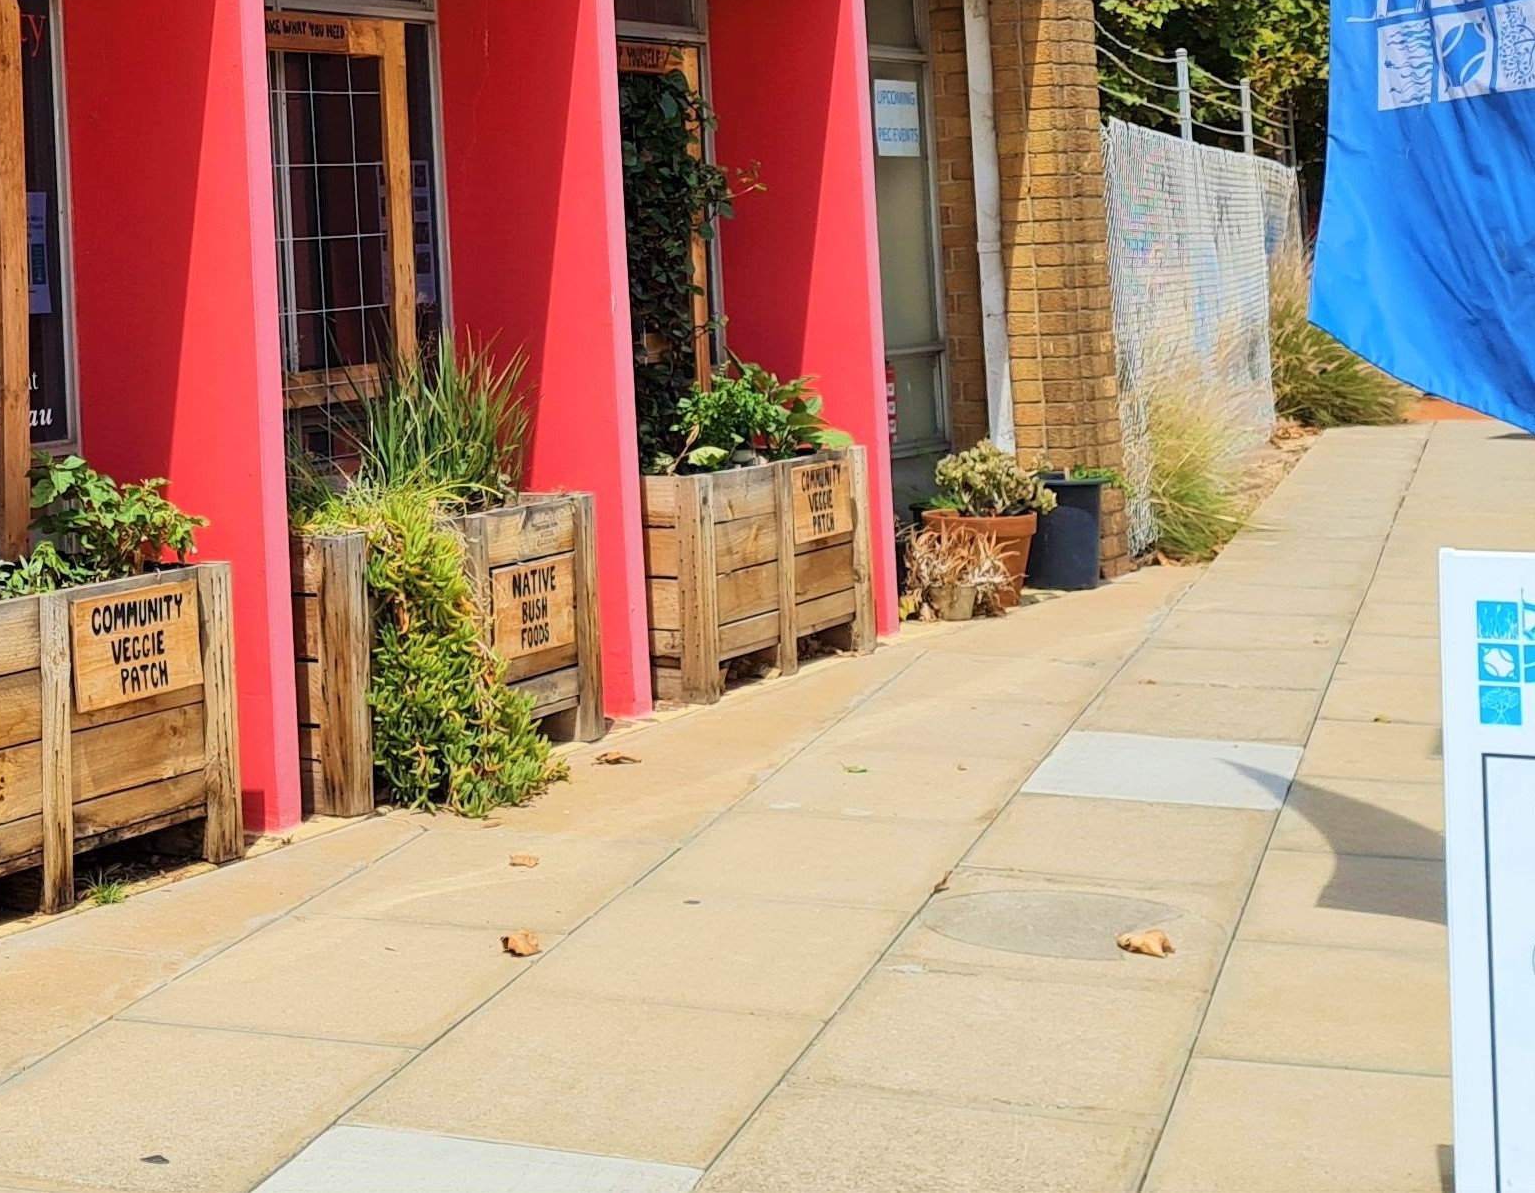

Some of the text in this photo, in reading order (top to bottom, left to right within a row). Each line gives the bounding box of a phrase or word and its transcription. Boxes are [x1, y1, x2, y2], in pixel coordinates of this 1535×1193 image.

[266, 19, 345, 39] AKE WHAT YOU NEED
[877, 90, 915, 105] UPCOMING
[893, 127, 919, 143] EVENTS
[801, 463, 841, 493] COMMUNITY
[807, 489, 833, 513] VEGGIE
[813, 513, 834, 536] PATCH
[512, 566, 556, 599] NATIVE
[91, 593, 183, 636] COMMUNITY
[521, 597, 548, 624] BUSH
[111, 630, 165, 665] VEGGIE
[521, 623, 550, 650] FOODS
[120, 660, 169, 695] PATCH
